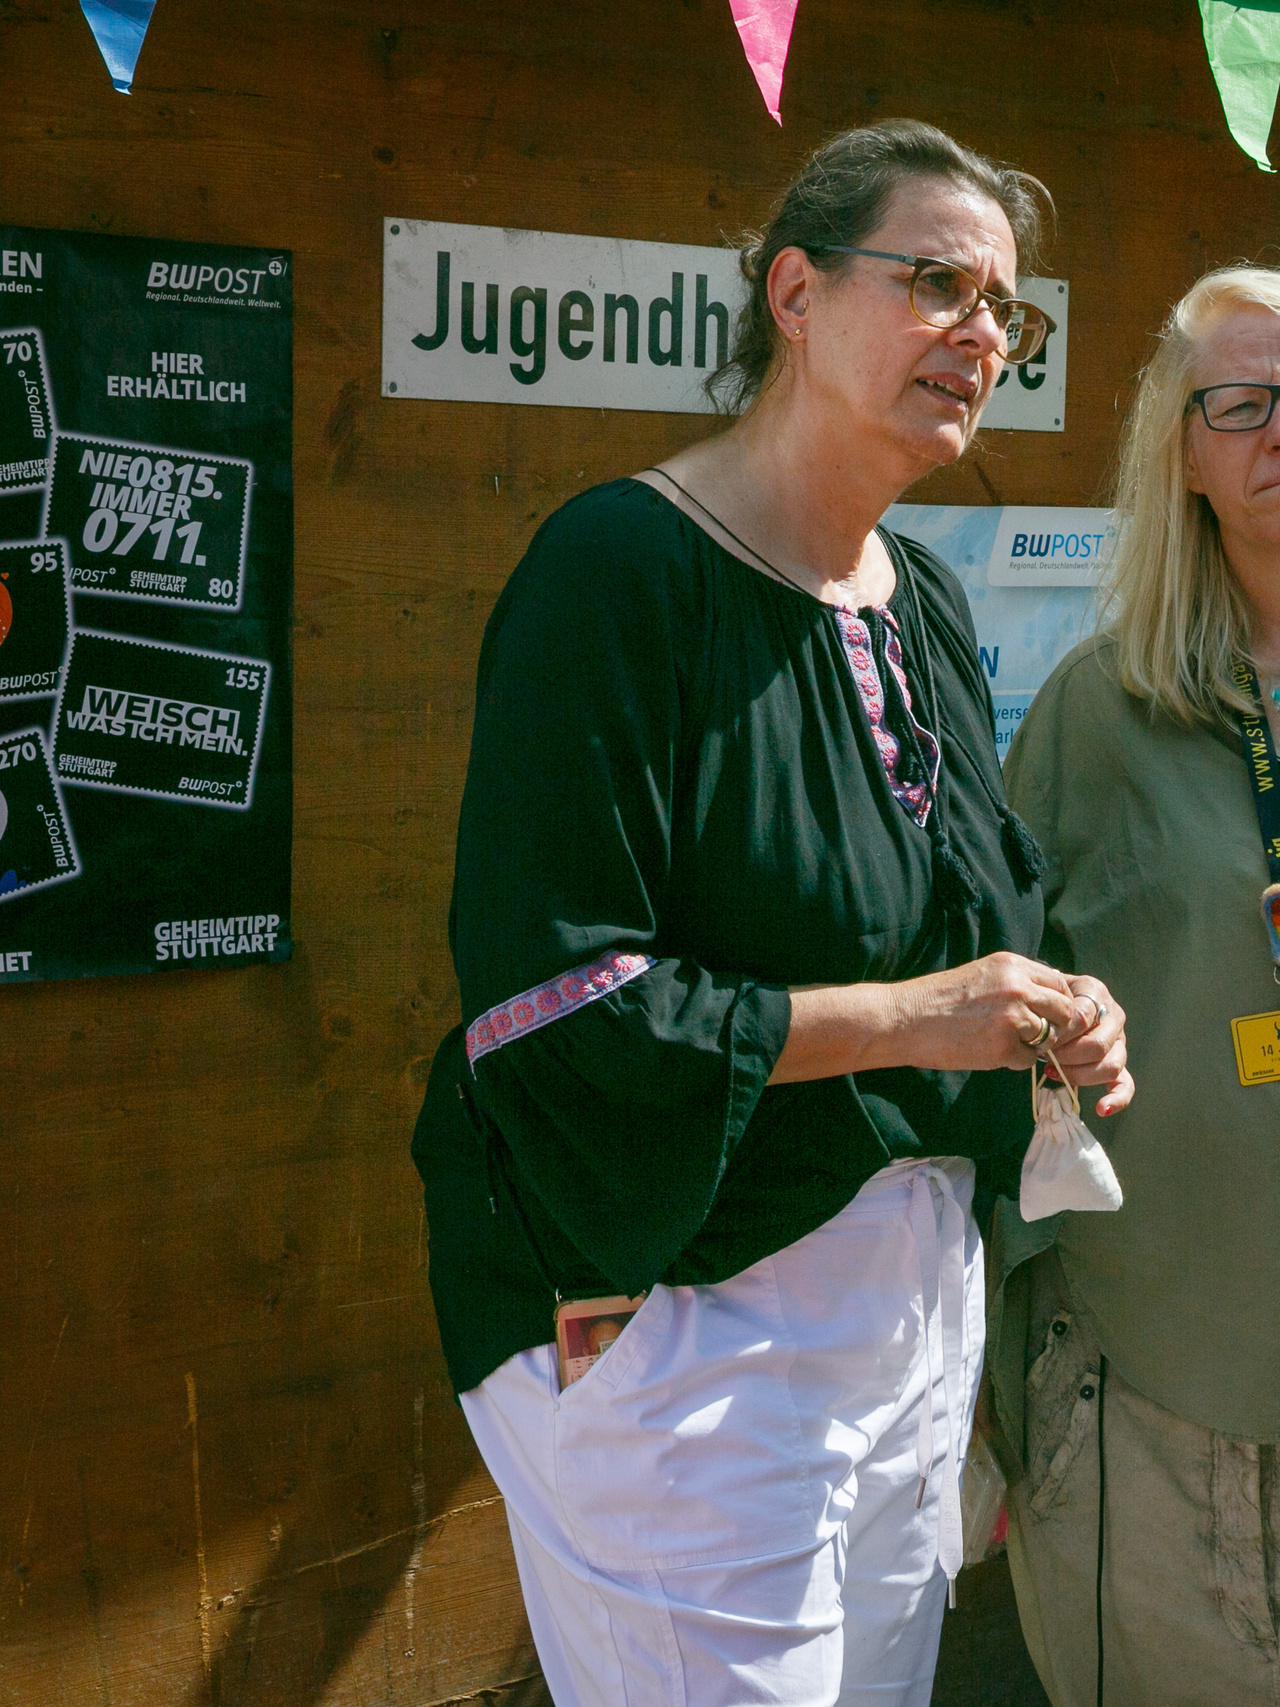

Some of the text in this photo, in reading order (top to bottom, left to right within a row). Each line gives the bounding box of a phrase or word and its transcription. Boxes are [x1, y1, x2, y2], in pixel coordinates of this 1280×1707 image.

[0, 250, 42, 278] EN
[147, 262, 266, 295] BWPOST
[146, 290, 282, 309] Regional. Deutschlandweit. Weltweit.
[3, 341, 32, 365] 70
[151, 352, 204, 375] HIER
[107, 373, 246, 402] ERHÄLTLICH
[26, 378, 46, 439] BWPOST
[89, 483, 192, 520] IMMER
[82, 508, 206, 566] 0711.
[1011, 533, 1104, 558] BWPOST
[30, 552, 57, 573] 95
[1009, 562, 1037, 571] Regional.
[68, 567, 108, 583] POST
[129, 578, 186, 593] STUTTGART
[130, 570, 187, 584] GEHEIMTIPP
[208, 578, 233, 598] 80
[0, 671, 57, 690] BWPOST
[225, 667, 260, 690] 155
[86, 688, 238, 738] WEISCH
[0, 741, 36, 770] 270
[59, 753, 117, 770] GEHEIMTIPP
[58, 762, 115, 778] STUTTGART
[178, 776, 235, 796] BWPOST
[44, 812, 69, 867] BWPOST
[154, 914, 280, 941] GEHEIMTIPP
[155, 933, 278, 961] STUTTGART
[1261, 1044, 1274, 1057] 14
